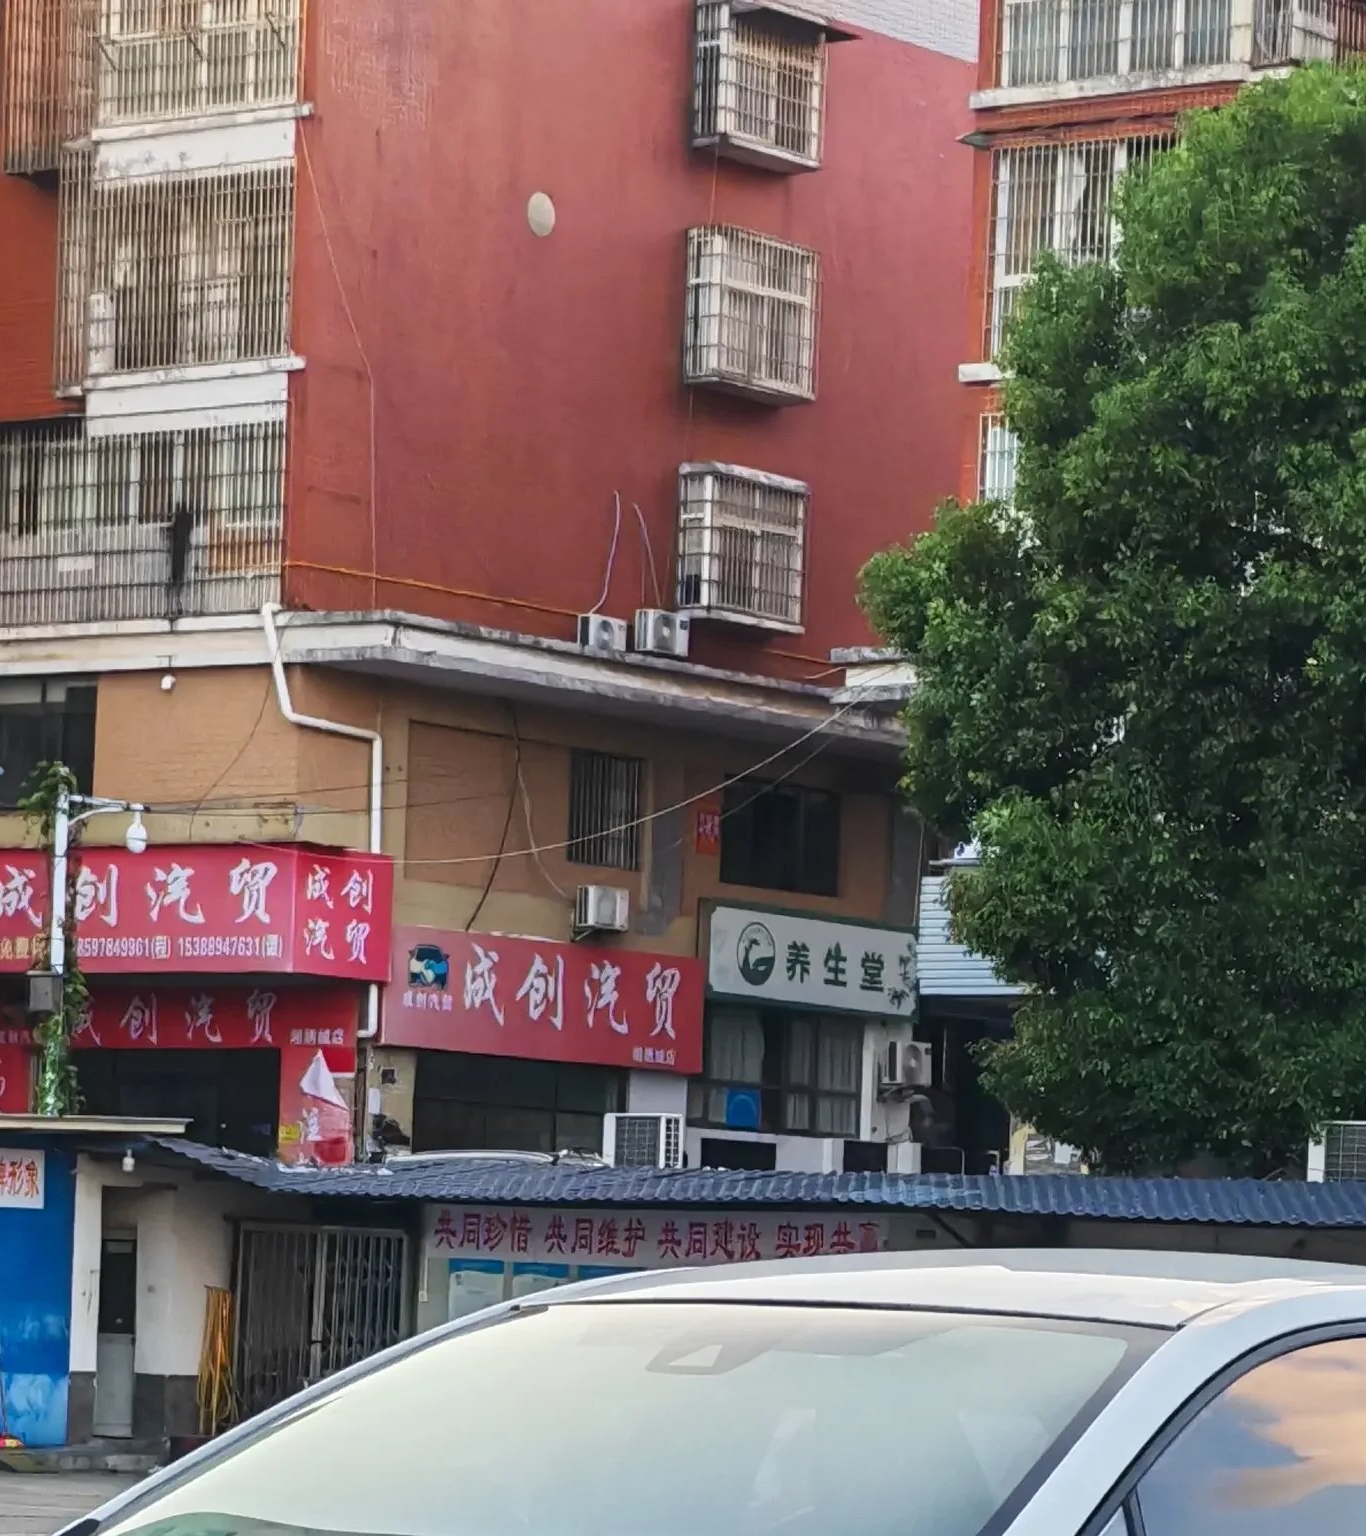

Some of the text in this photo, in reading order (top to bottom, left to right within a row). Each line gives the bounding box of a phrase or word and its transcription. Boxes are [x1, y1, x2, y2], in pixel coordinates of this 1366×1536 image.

[307, 863, 374, 915] 成创
[304, 918, 371, 964] 汽贸
[786, 940, 885, 992] 养生堂
[464, 942, 681, 1040] 成创汽贸
[434, 1212, 532, 1254] 共同珍惜
[544, 1215, 648, 1257] 共同维护
[657, 1219, 763, 1261] 共同建设
